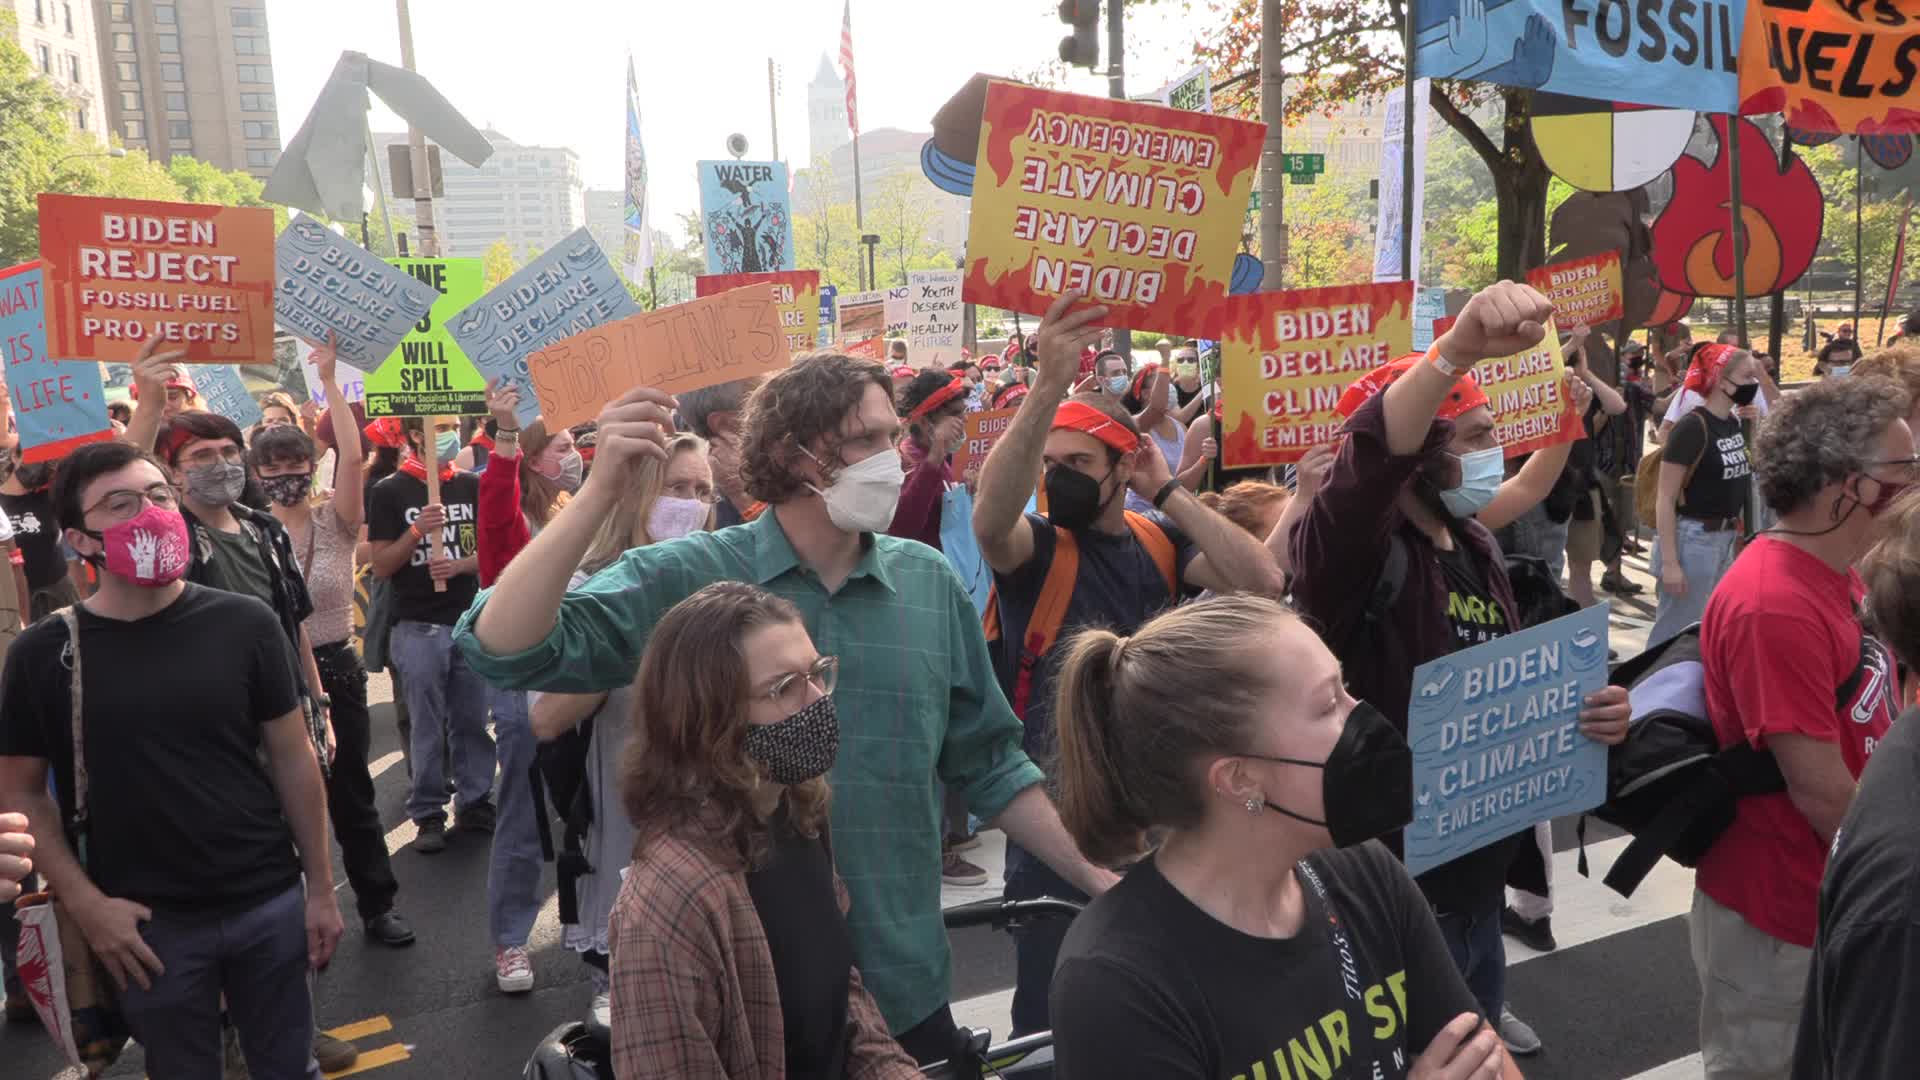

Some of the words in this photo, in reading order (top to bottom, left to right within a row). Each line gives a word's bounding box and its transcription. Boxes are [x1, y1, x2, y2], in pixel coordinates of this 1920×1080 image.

[1562, 0, 1738, 73] FOSSIL
[1764, 22, 1920, 98] UELS
[1029, 114, 1215, 168] EMERGENCY
[714, 165, 773, 183] WATER
[1289, 155, 1305, 170] 15
[1022, 158, 1204, 215] CLIMATE
[103, 214, 216, 246] BIDEN
[1013, 206, 1198, 261] DECLARE
[80, 247, 239, 283] REJECT
[321, 245, 398, 297] BIDEN
[1034, 256, 1162, 303] BIDEN
[1552, 264, 1598, 285] BIDEN
[0, 280, 39, 318] WAT
[82, 289, 174, 311] FOSSIL
[178, 293, 239, 312] FUEL
[293, 256, 396, 322] DECLARE
[493, 261, 570, 322] BIDEN
[912, 300, 959, 313] DESERVE
[922, 285, 954, 298] YOUTH
[279, 277, 381, 341] CLIMATE
[496, 275, 599, 354] DECLARE
[930, 313, 937, 322] A
[1277, 304, 1371, 341] BIDEN
[83, 317, 240, 341] PROJECTS
[912, 323, 959, 335] HEALTHY
[7, 333, 33, 366] IS
[401, 341, 449, 365] WILL
[534, 335, 612, 416] STOP
[624, 302, 744, 387] LINE
[737, 299, 781, 364] 3
[1261, 341, 1388, 379] DECLARE
[400, 367, 453, 391] SPILL
[1263, 384, 1341, 415] CLIM
[1488, 380, 1558, 417] LIMATE
[979, 416, 1009, 433] BIDE
[405, 503, 473, 524] GEN
[1463, 640, 1562, 701] BIDEN
[1440, 680, 1579, 752] DECLARE
[1438, 721, 1576, 797] CLIMATE
[1437, 764, 1573, 837] EMERGENCY
